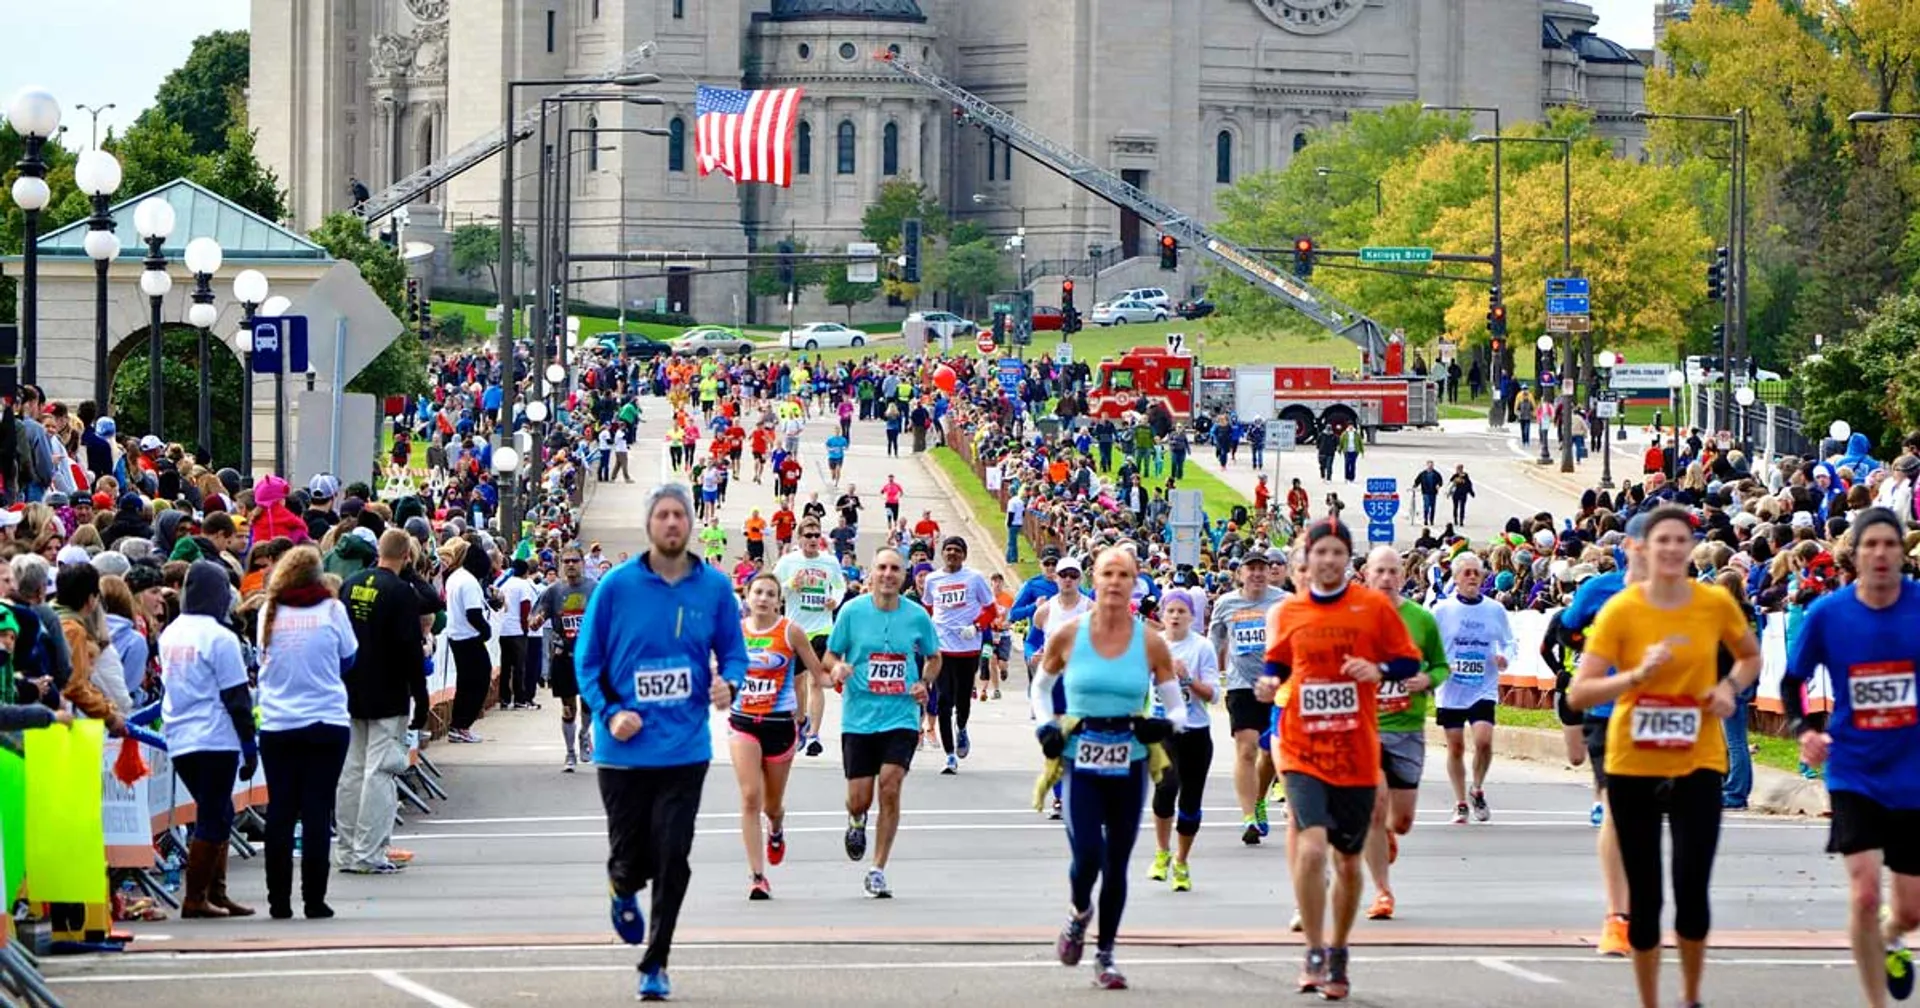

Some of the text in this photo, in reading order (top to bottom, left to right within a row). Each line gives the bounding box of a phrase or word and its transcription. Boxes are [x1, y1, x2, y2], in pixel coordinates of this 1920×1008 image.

[1366, 251, 1427, 260] Kellogg Blvd
[1368, 481, 1395, 491] SOUTH
[1368, 502, 1393, 516] 35E
[940, 590, 965, 603] 7317
[1236, 628, 1267, 643] 4440
[870, 662, 905, 678] 7678
[1456, 660, 1485, 673] 1205
[637, 672, 689, 698] 5524
[1854, 678, 1912, 705] 8557
[1303, 686, 1356, 711] 6938
[1079, 743, 1129, 764] 3243
